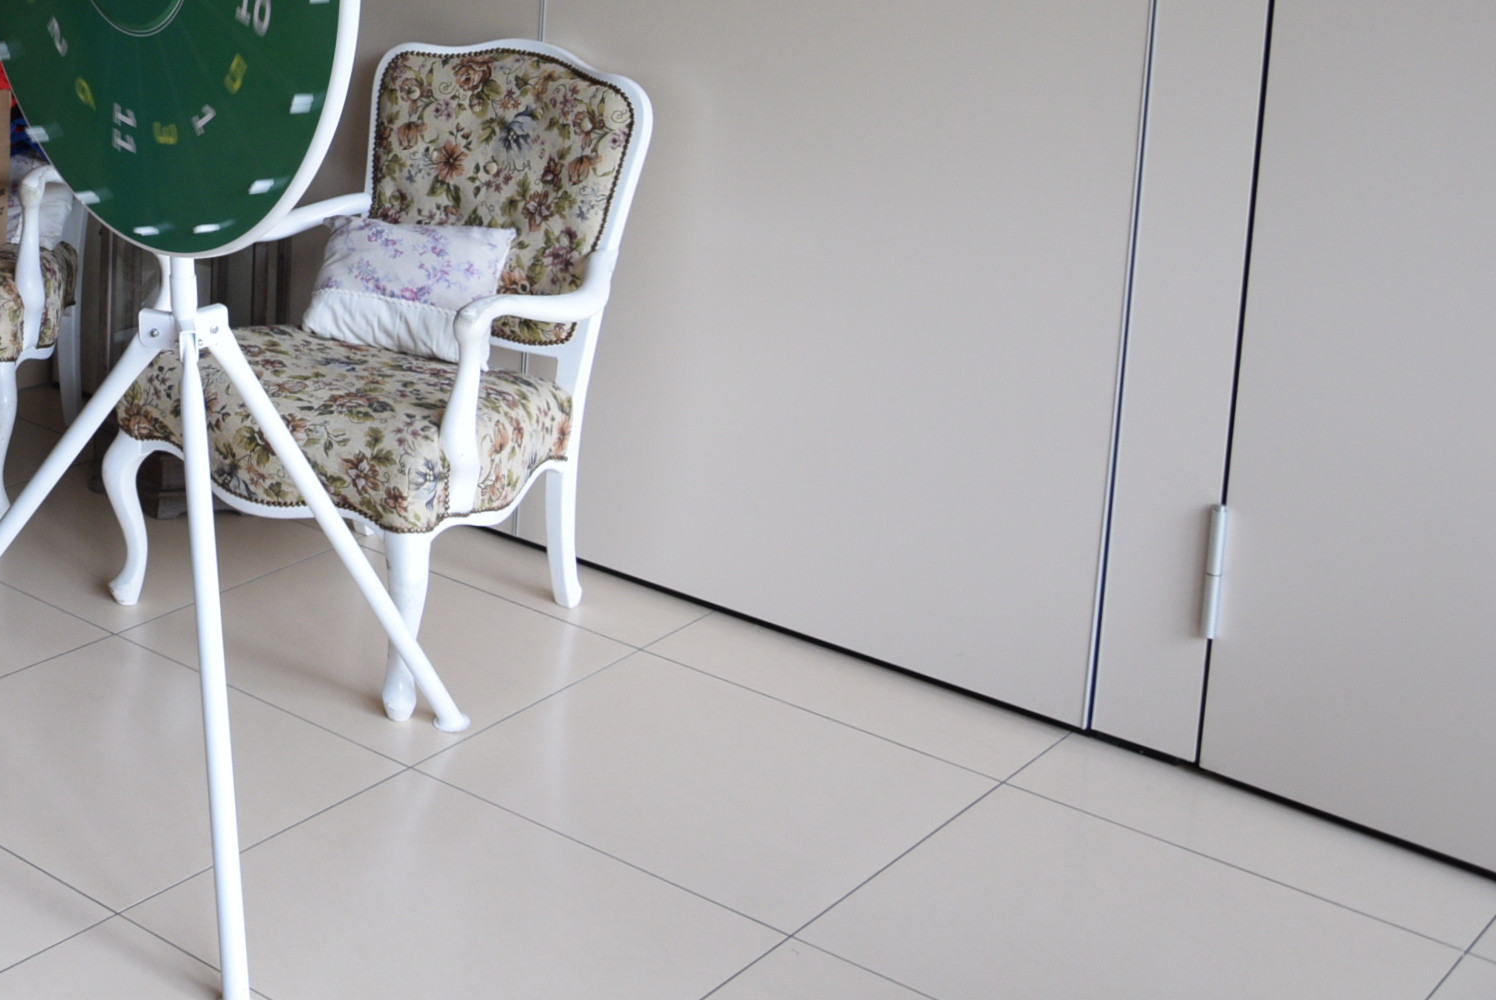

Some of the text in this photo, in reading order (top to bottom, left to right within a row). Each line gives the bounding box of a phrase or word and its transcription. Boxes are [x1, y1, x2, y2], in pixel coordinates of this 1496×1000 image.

[47, 15, 69, 57] 2
[112, 102, 137, 154] 11
[191, 104, 216, 136] 1
